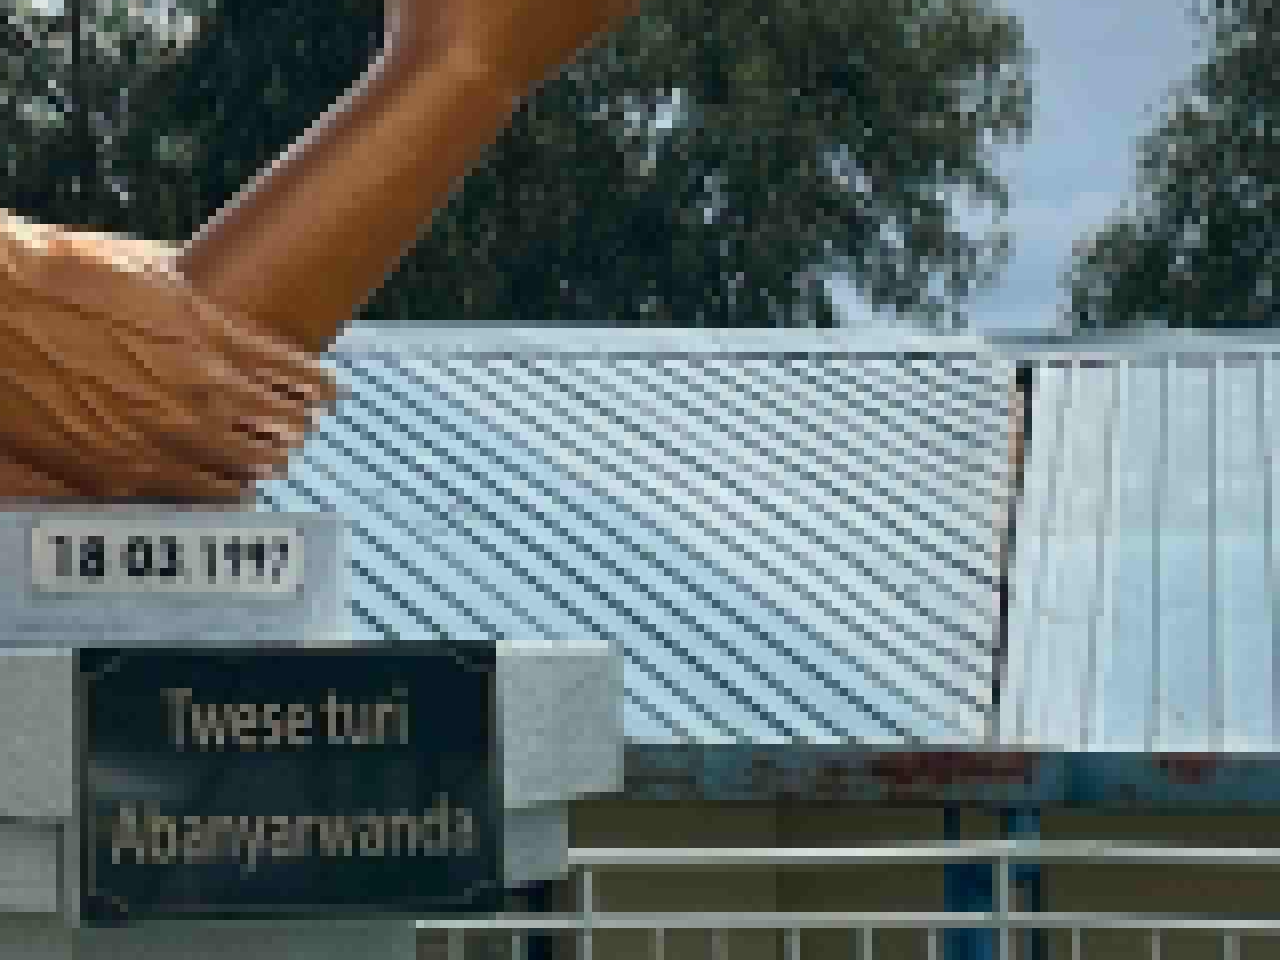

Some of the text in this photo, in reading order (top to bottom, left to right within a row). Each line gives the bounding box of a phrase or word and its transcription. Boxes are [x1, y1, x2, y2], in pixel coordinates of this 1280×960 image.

[52, 536, 105, 582] 18
[162, 683, 409, 748] Twese turi
[111, 793, 478, 874] Abanyarwanda
